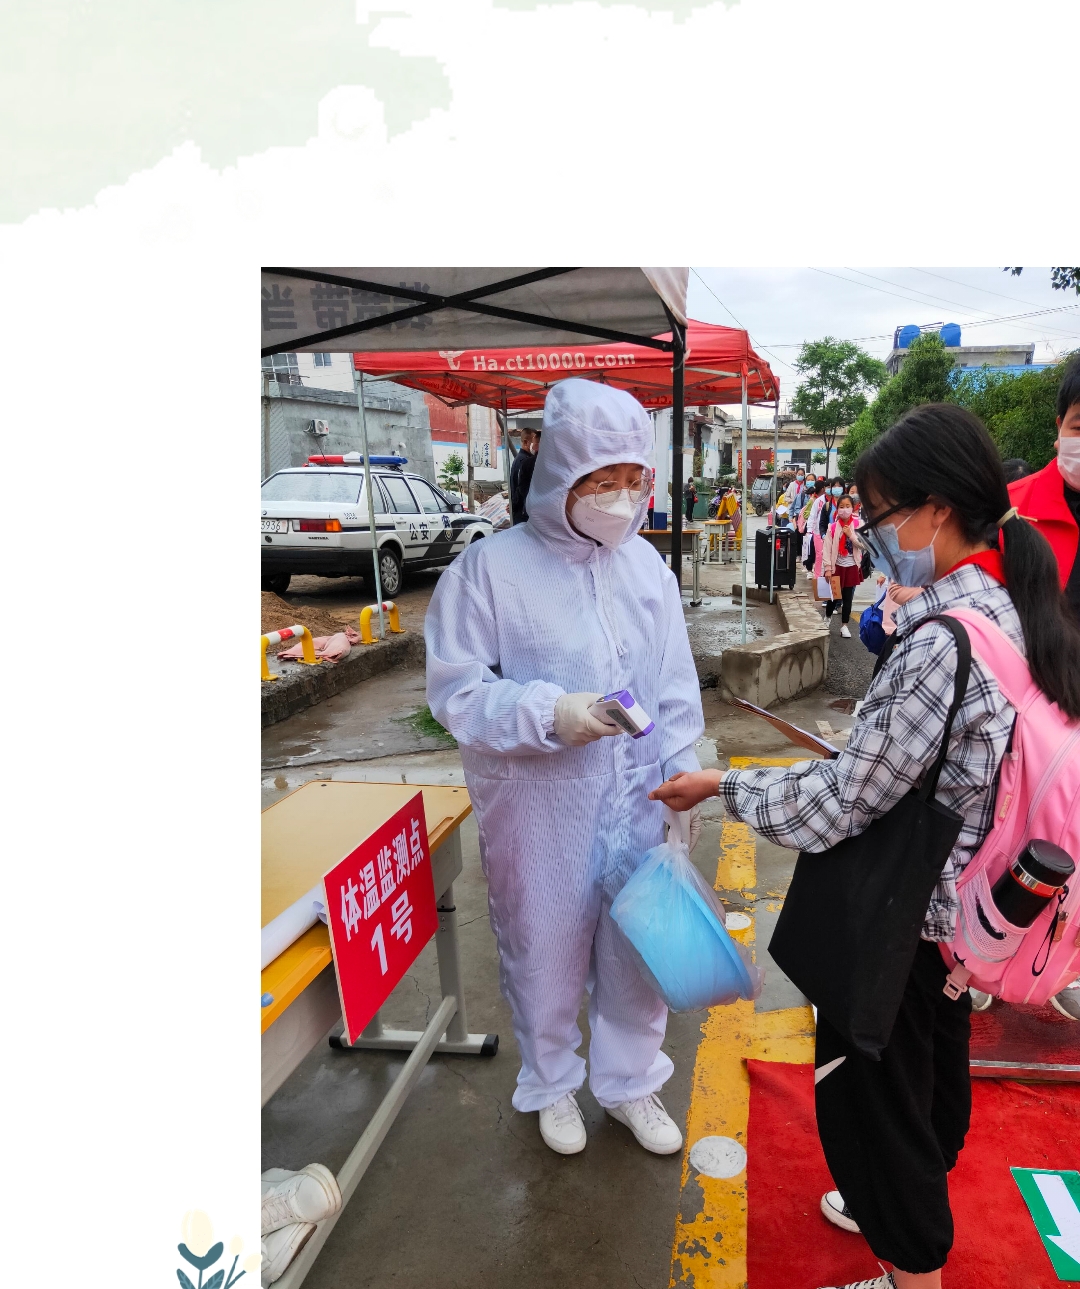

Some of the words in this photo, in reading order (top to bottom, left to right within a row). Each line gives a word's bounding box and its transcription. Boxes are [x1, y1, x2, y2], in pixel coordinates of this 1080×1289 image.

[473, 352, 636, 372] Ha.ct10000.com
[409, 522, 429, 541] 公安
[340, 818, 425, 942] 体温监测点
[370, 890, 414, 976] 1号
